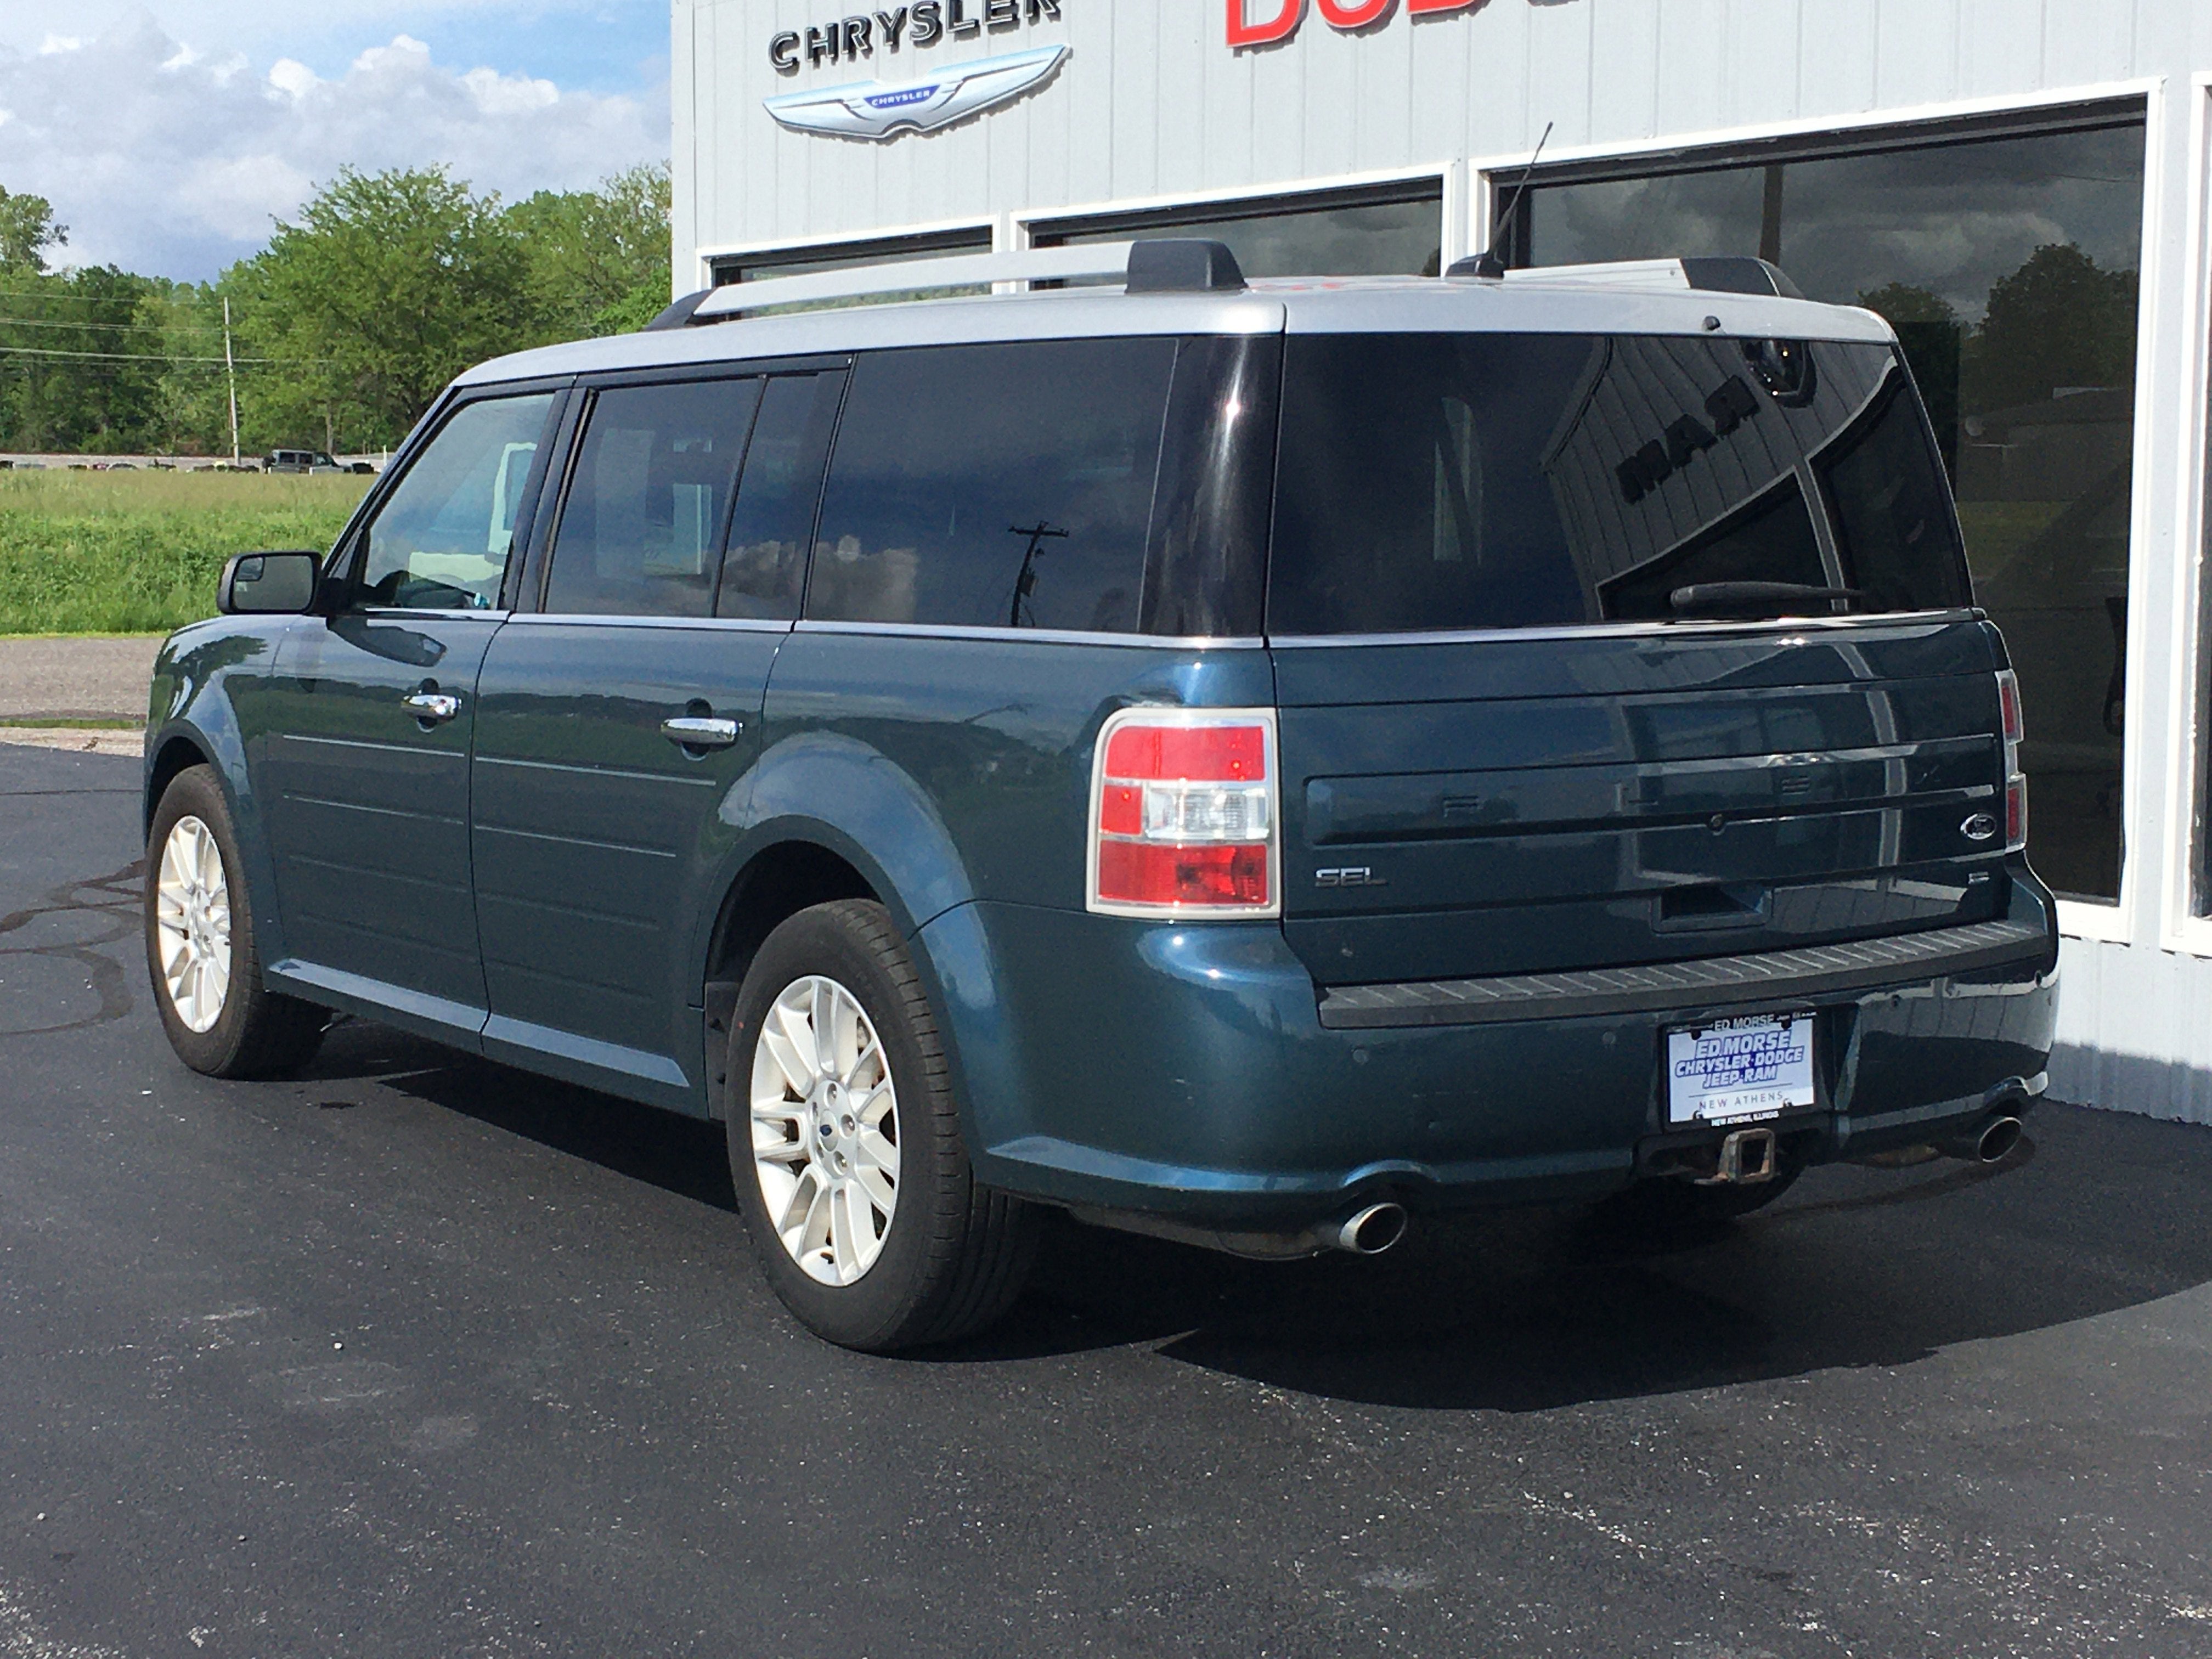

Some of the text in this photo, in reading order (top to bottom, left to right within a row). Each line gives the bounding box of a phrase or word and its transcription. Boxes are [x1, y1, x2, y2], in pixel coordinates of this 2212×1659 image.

[871, 89, 930, 106] CHRYSLER
[1316, 867, 1389, 888] SEL
[1714, 1020, 1730, 1031] ED
[1733, 1014, 1774, 1030] MORSE
[1695, 1030, 1791, 1058] ED MORSE
[1699, 1091, 1784, 1109] NEW ATHENS
